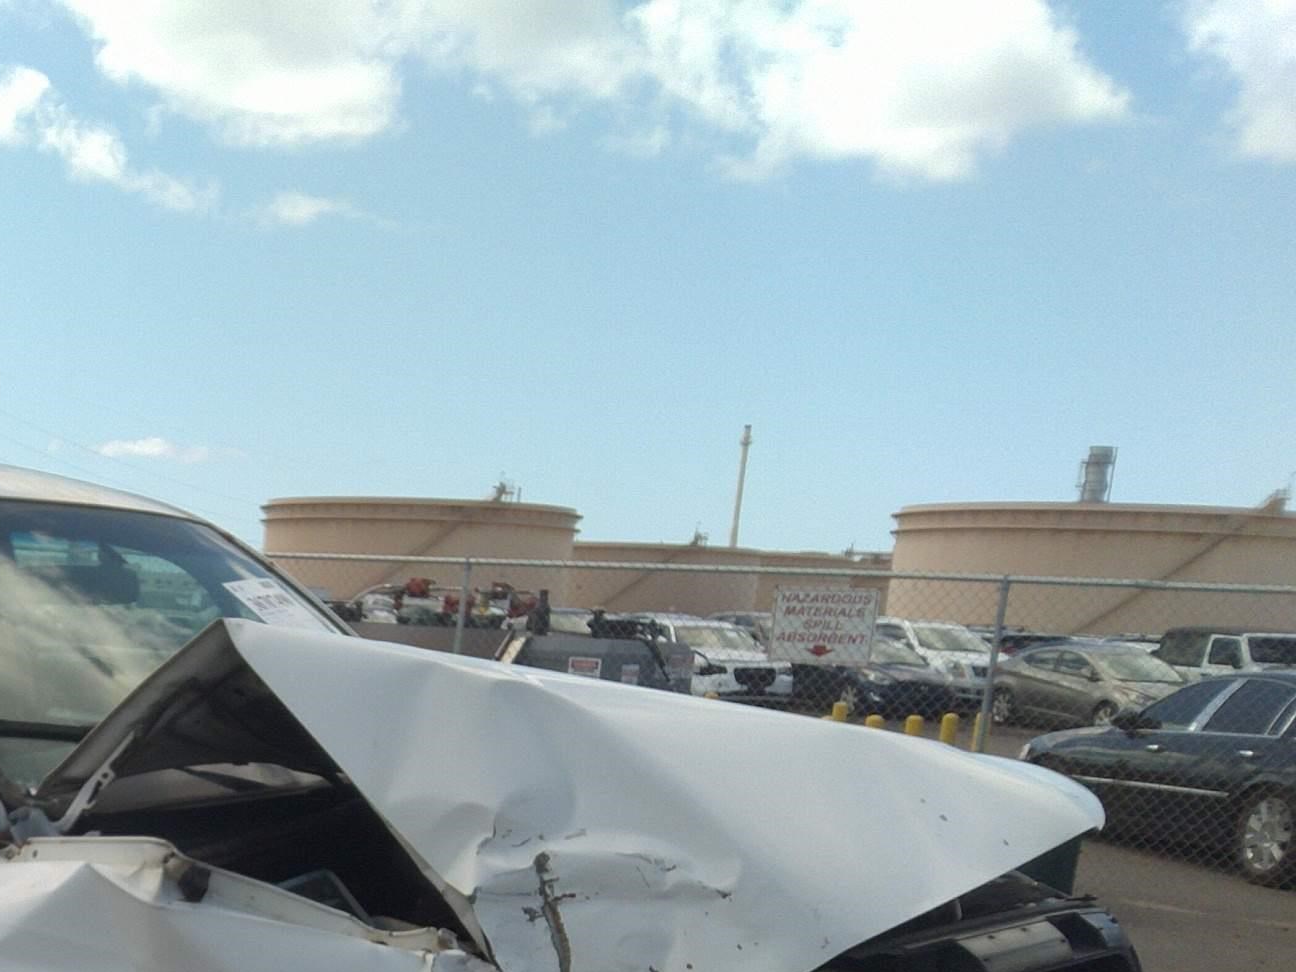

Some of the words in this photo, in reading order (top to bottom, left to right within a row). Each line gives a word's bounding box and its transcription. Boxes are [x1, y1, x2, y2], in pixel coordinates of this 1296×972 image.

[781, 592, 873, 605] HAZARDOUS
[783, 605, 866, 618] MATERIALS
[802, 618, 843, 631] SPILL
[776, 632, 866, 645] ABSORBENT
